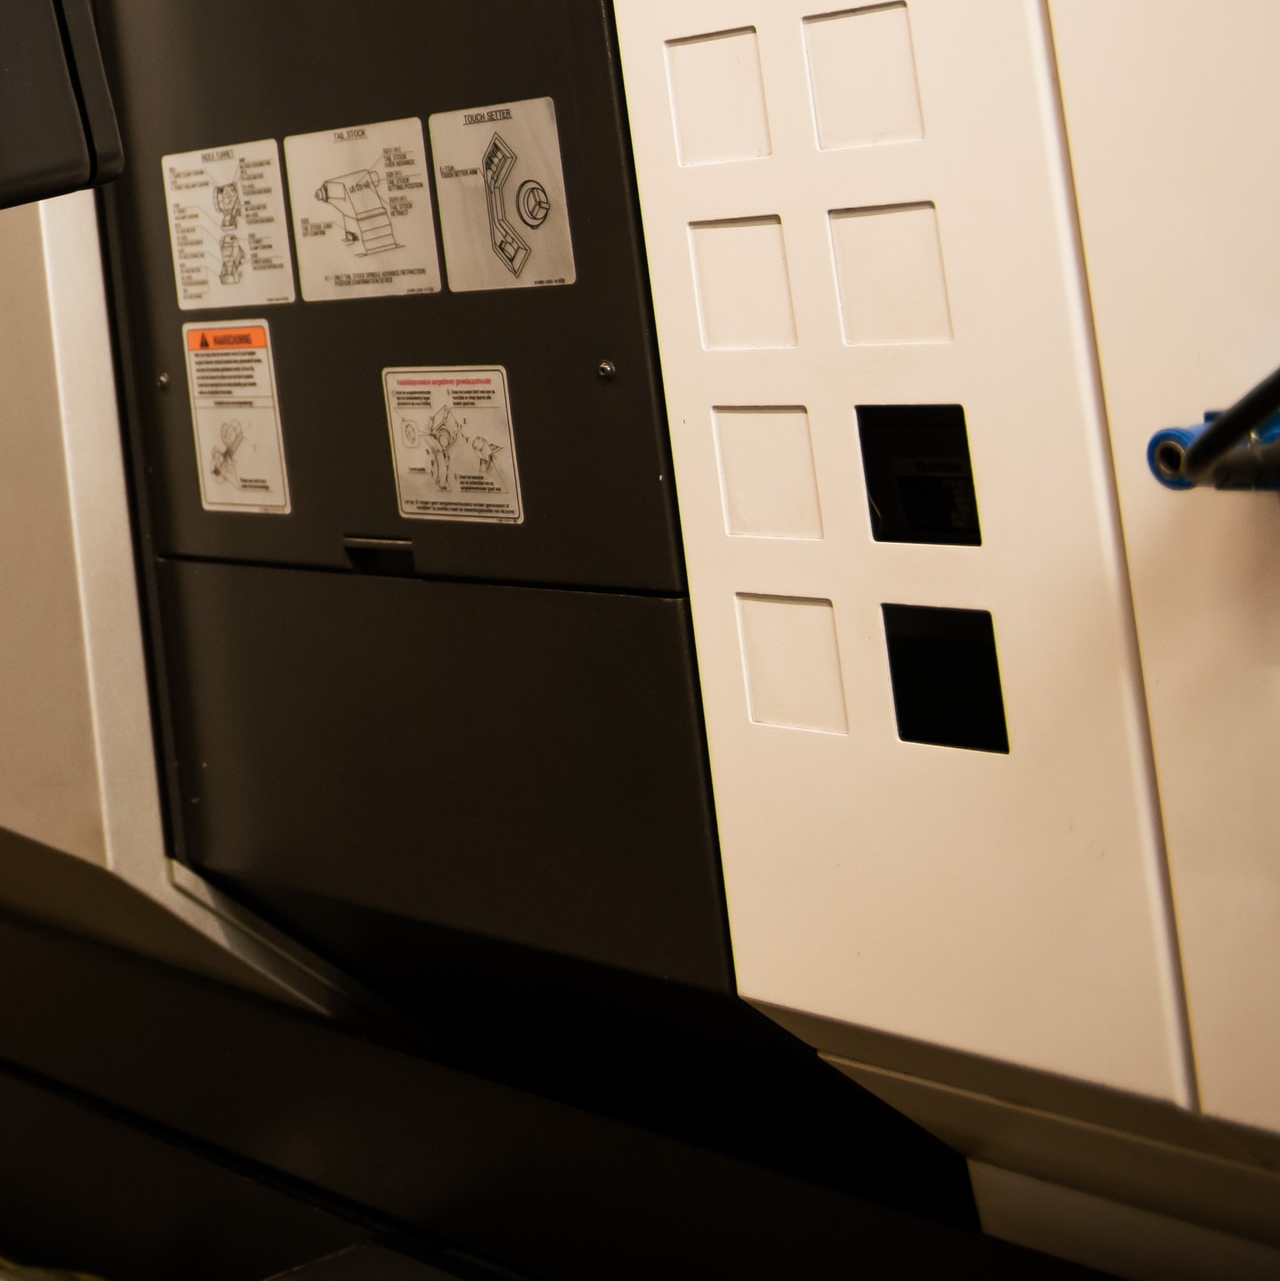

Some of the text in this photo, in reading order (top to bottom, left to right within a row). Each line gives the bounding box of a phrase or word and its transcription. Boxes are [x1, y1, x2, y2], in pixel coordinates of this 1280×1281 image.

[463, 108, 512, 124] TOUCH SETTER
[333, 129, 366, 140] TAIL STOCK
